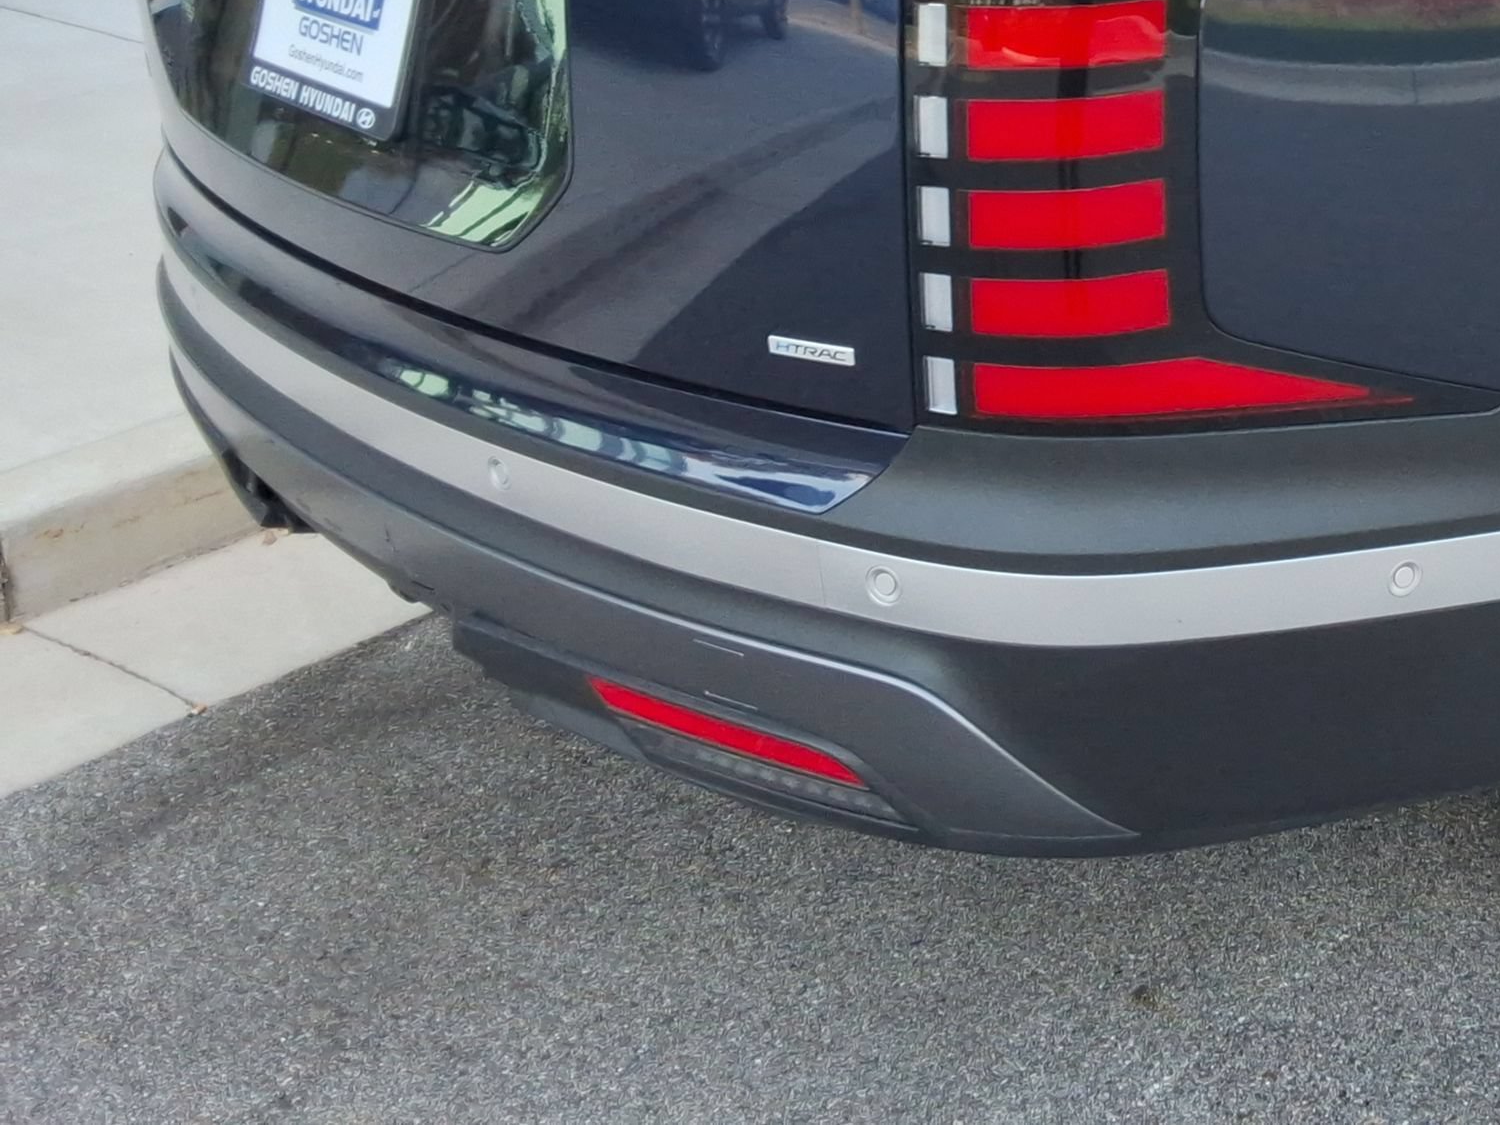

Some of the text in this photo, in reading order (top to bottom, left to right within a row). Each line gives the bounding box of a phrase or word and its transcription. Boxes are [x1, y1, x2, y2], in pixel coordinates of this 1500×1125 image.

[298, 16, 364, 56] GOSHEN
[250, 66, 356, 122] GOSHEN HYUNDAI
[776, 342, 847, 362] HTRAC
